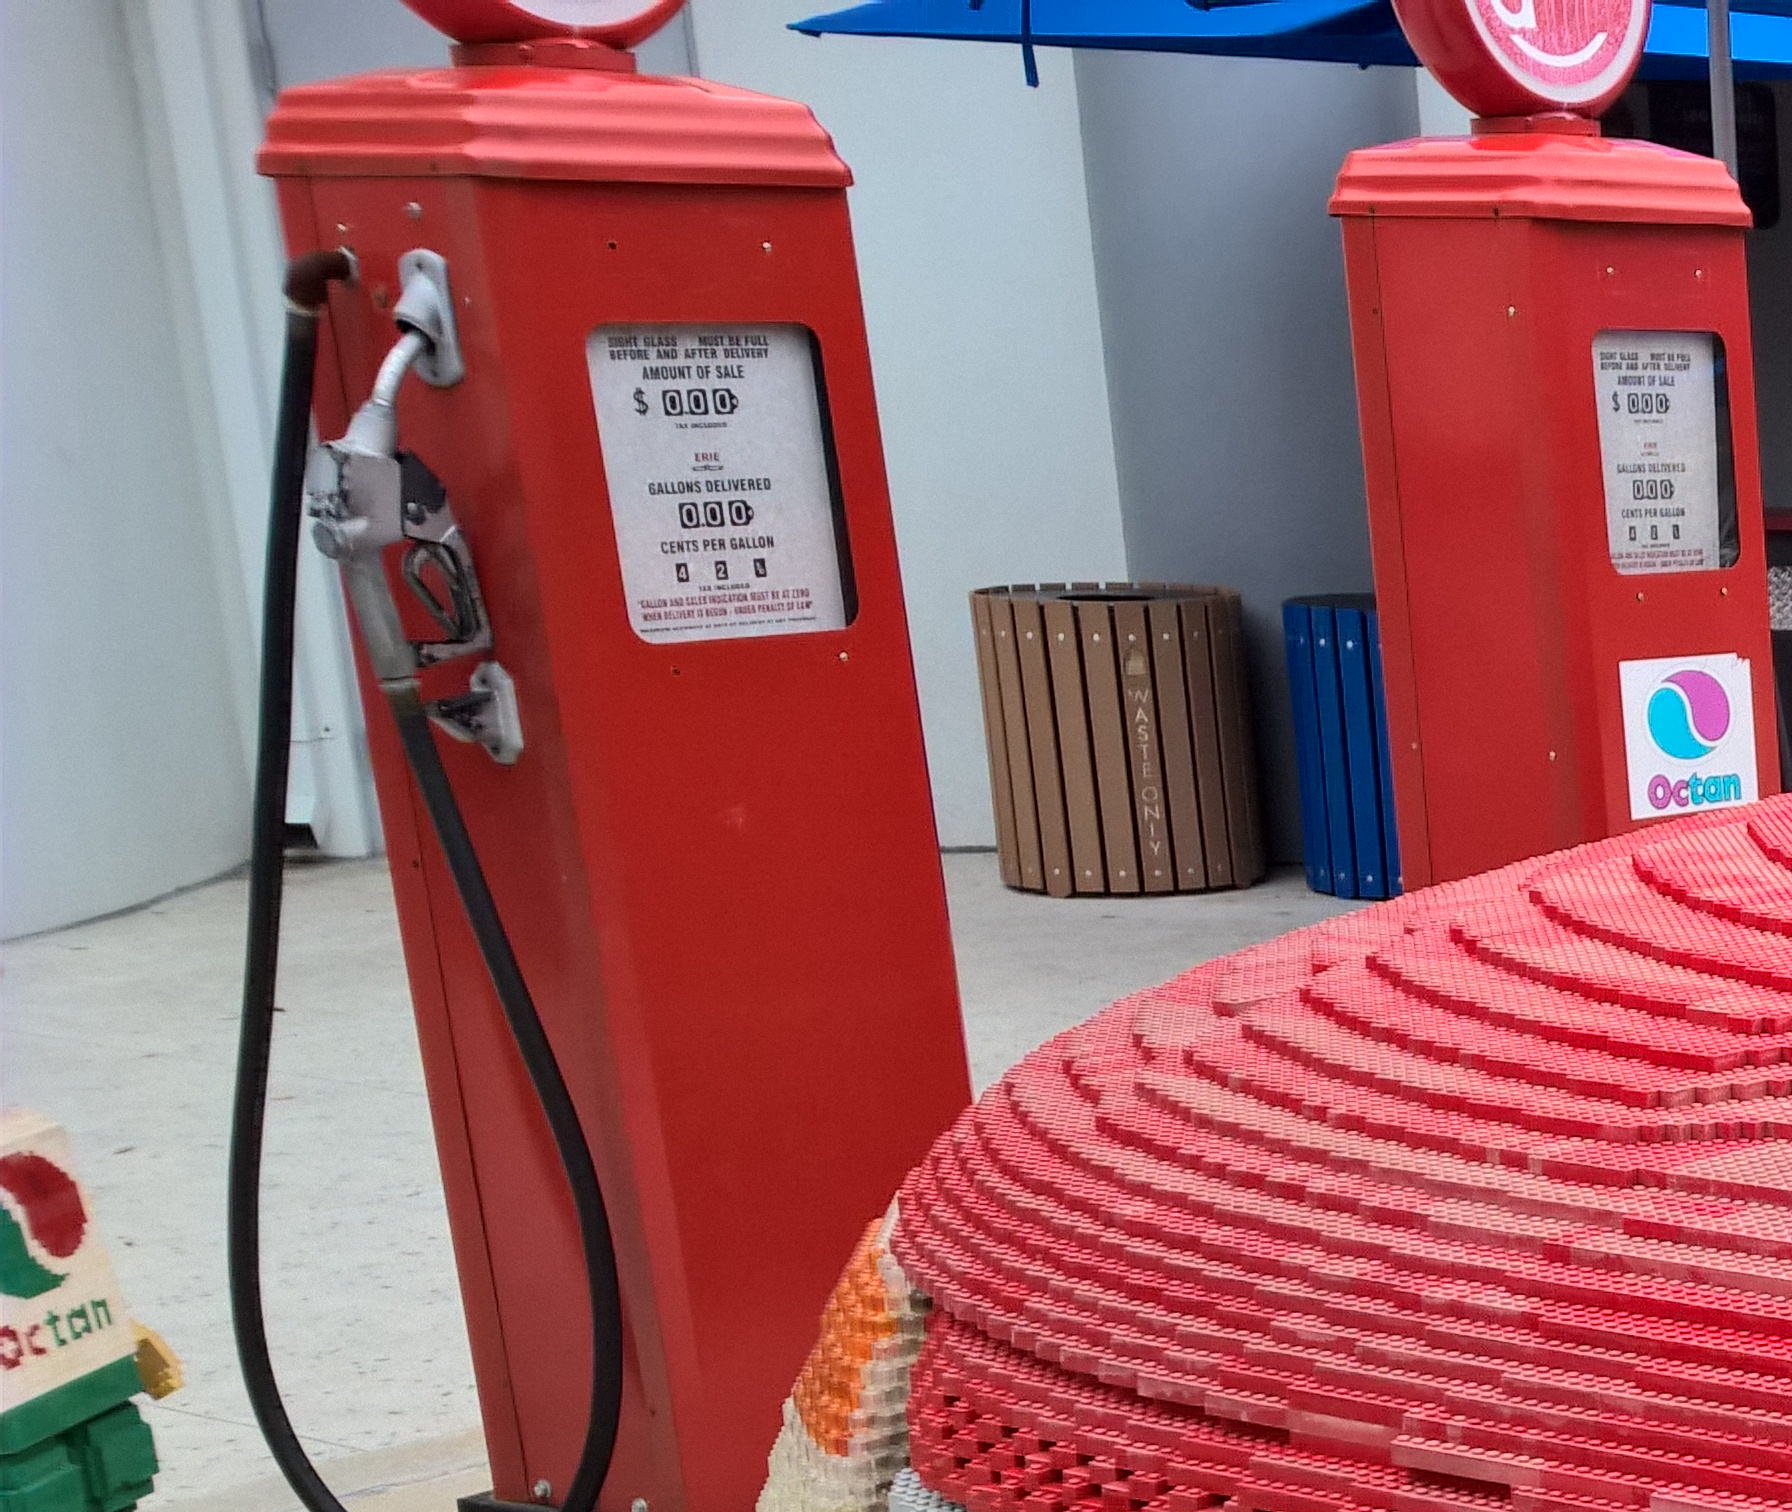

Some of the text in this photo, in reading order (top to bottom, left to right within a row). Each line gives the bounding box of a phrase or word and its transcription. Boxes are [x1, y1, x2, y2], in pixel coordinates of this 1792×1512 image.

[643, 335, 677, 347] GLASS
[698, 335, 724, 346] MUST
[728, 335, 741, 346] BE
[744, 335, 769, 346] FULL
[609, 347, 769, 361] BEFORE AND AFTER DELIVERY
[642, 365, 745, 380] AMOUNT OF SALE
[1617, 375, 1645, 386] AMOUNT
[1647, 375, 1655, 387] OF
[633, 387, 649, 416] $
[1612, 391, 1620, 413] $
[694, 452, 720, 462] ERIE
[1617, 463, 1686, 474] GALLONS DELIVERED
[648, 478, 771, 495] GALLONS DELIVERED
[1622, 507, 1685, 519] CENTS PER GALLON
[660, 536, 775, 554] CENTS PER GALLON
[676, 564, 689, 581] 4
[715, 562, 728, 579] 2
[1127, 689, 1151, 778] WASTE
[1647, 771, 1742, 810] Octan
